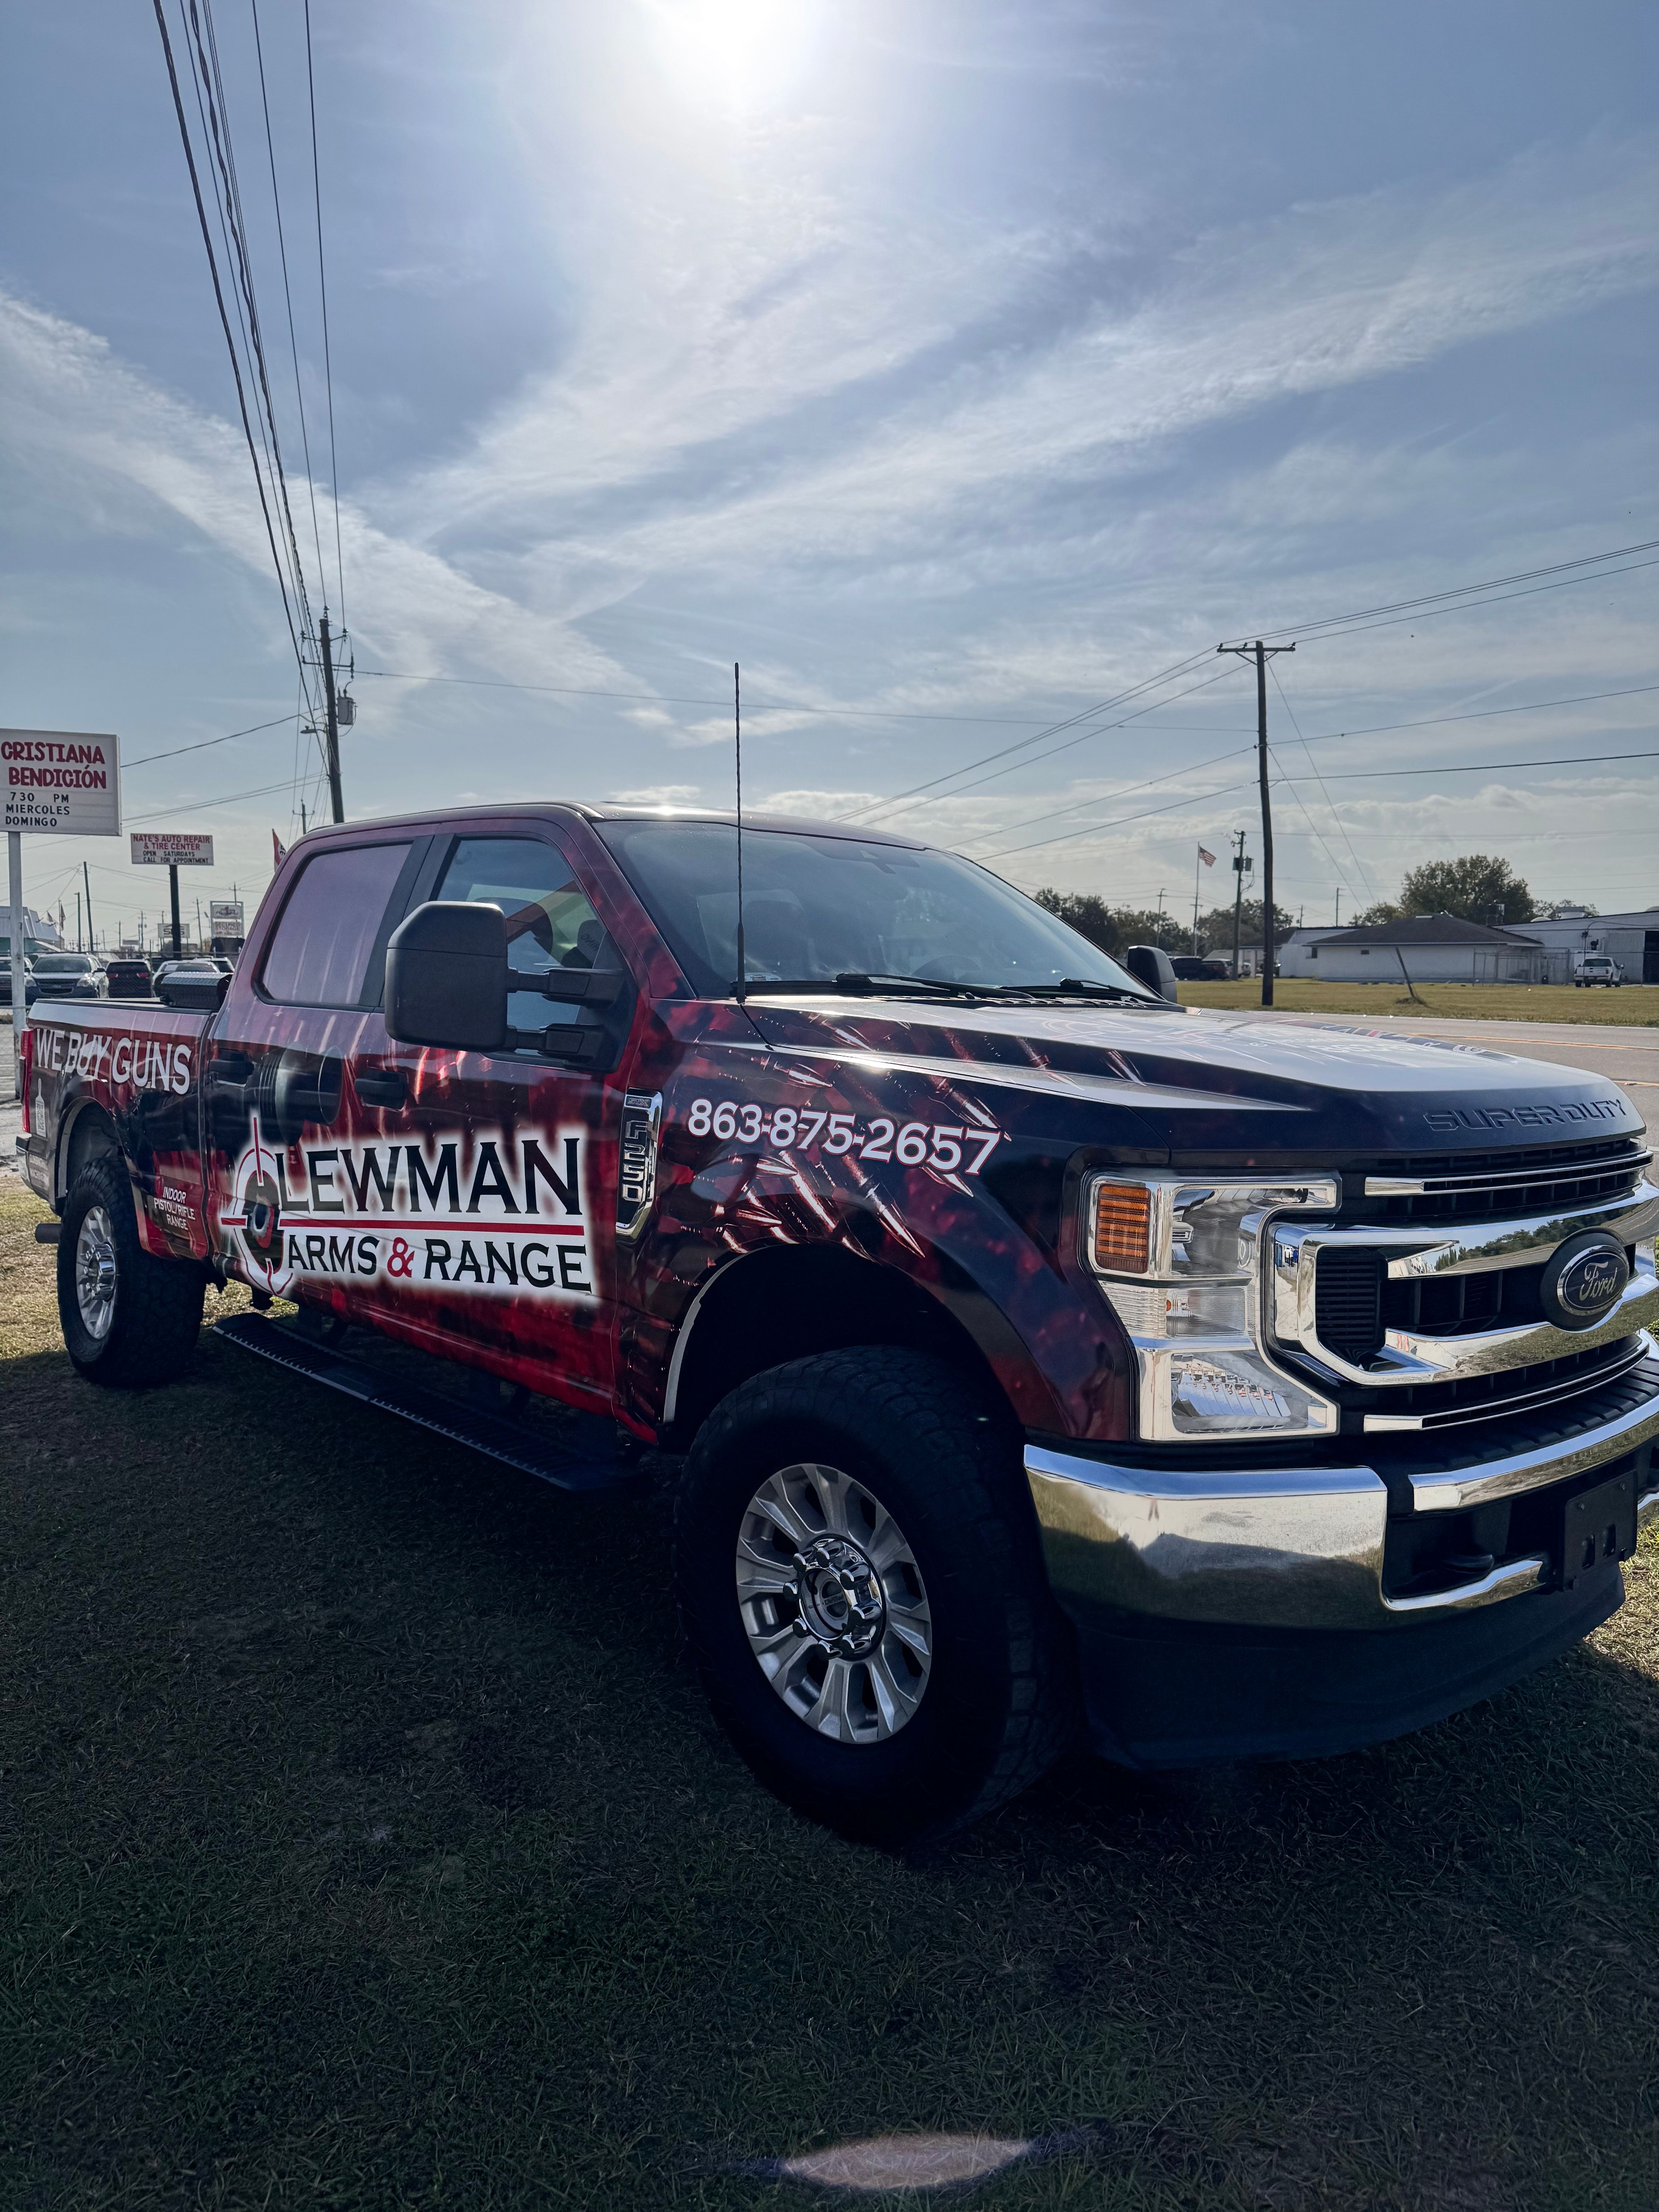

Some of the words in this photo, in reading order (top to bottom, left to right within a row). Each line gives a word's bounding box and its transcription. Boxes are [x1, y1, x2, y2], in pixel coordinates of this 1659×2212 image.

[1, 741, 105, 764] CRISTIANA
[9, 764, 106, 789] BENDICIÓN
[6, 804, 70, 815] MIERCOLES
[53, 794, 69, 803] PM
[5, 816, 57, 827] DOMINGO
[37, 1028, 65, 1071] WE
[64, 1032, 112, 1079] BUY
[112, 1037, 192, 1095] GUNS
[627, 1097, 648, 1107] STX
[1423, 1106, 1565, 1131] SUPER
[1558, 1099, 1627, 1123] DUTY
[687, 1098, 1001, 1175] 863-875-2657
[274, 1138, 583, 1215] LEWMAN
[163, 1186, 186, 1204] INDOOR
[153, 1197, 196, 1220] PISTOL/RIFLE
[166, 1213, 189, 1230] RANGE
[288, 1235, 380, 1276] ARMS
[387, 1237, 414, 1278] &
[423, 1238, 592, 1294] RANGE
[1579, 1261, 1618, 1301] Ford
